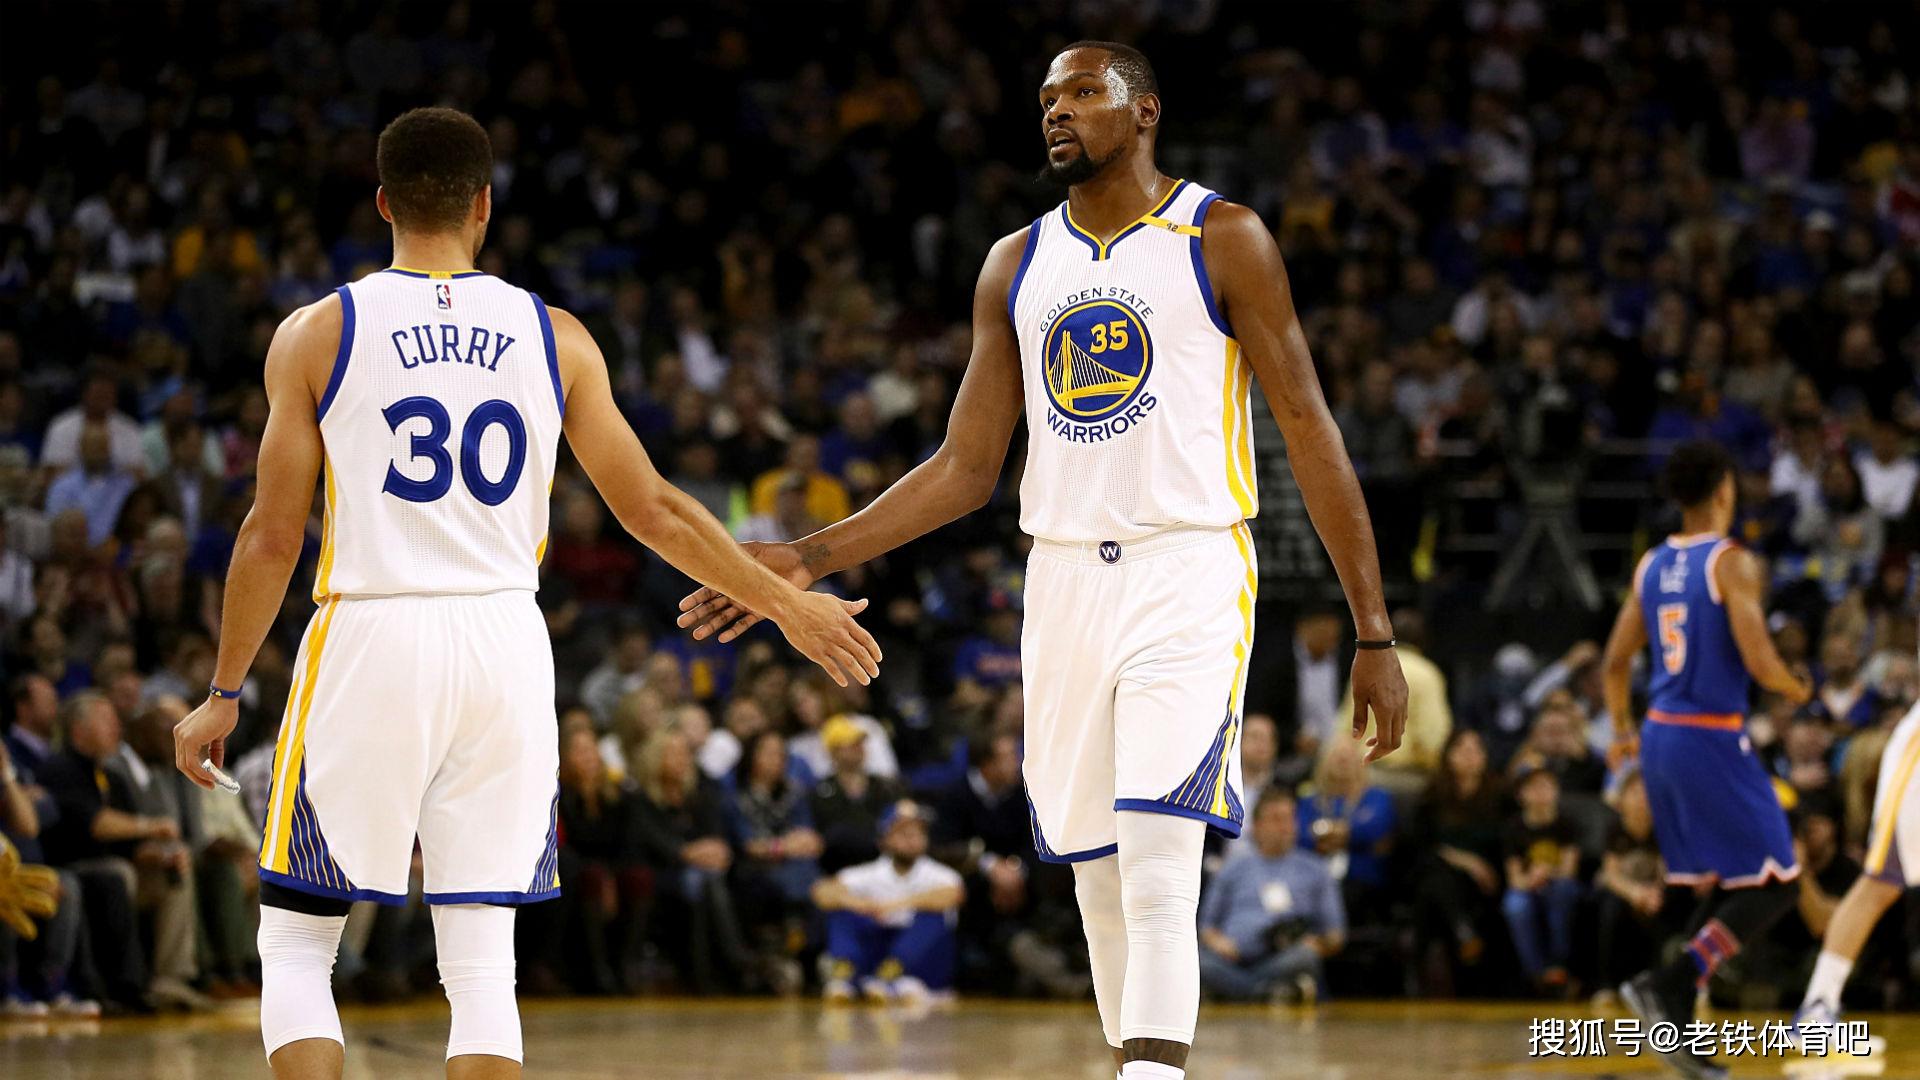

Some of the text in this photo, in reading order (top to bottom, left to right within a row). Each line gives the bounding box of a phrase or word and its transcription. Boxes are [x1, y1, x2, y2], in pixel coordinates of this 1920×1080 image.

[1040, 286, 1154, 333] GOLDEN STATE
[391, 324, 515, 372] CURRY
[1090, 318, 1128, 354] 35
[1047, 391, 1157, 443] WARRIORS
[381, 396, 527, 506] 30
[1101, 545, 1118, 559] W
[1657, 602, 1688, 675] 5
